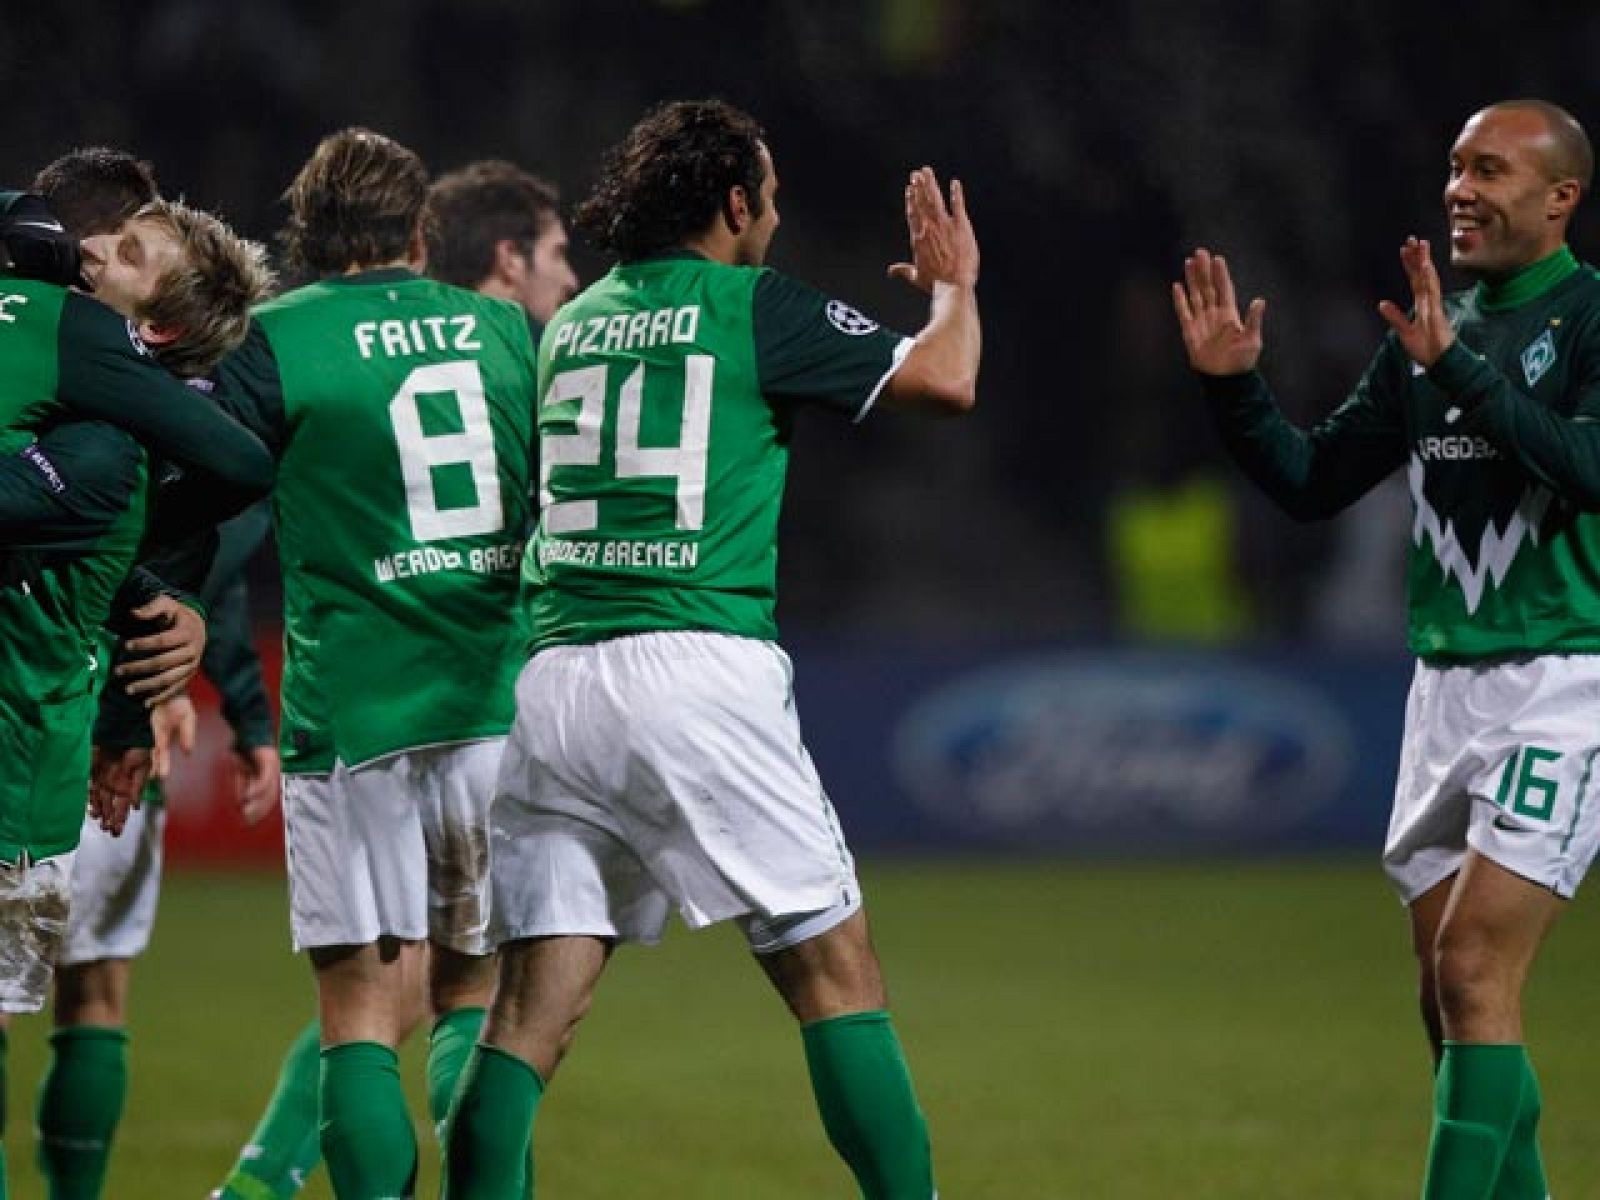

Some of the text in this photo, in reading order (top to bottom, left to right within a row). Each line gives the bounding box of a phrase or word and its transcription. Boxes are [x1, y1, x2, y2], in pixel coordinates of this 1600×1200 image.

[354, 314, 482, 359] FRITZ
[551, 304, 700, 359] PIZARRO
[388, 360, 504, 542] 8
[539, 354, 715, 533] 24
[602, 541, 699, 568] BREMEN
[1495, 745, 1564, 822] 16
